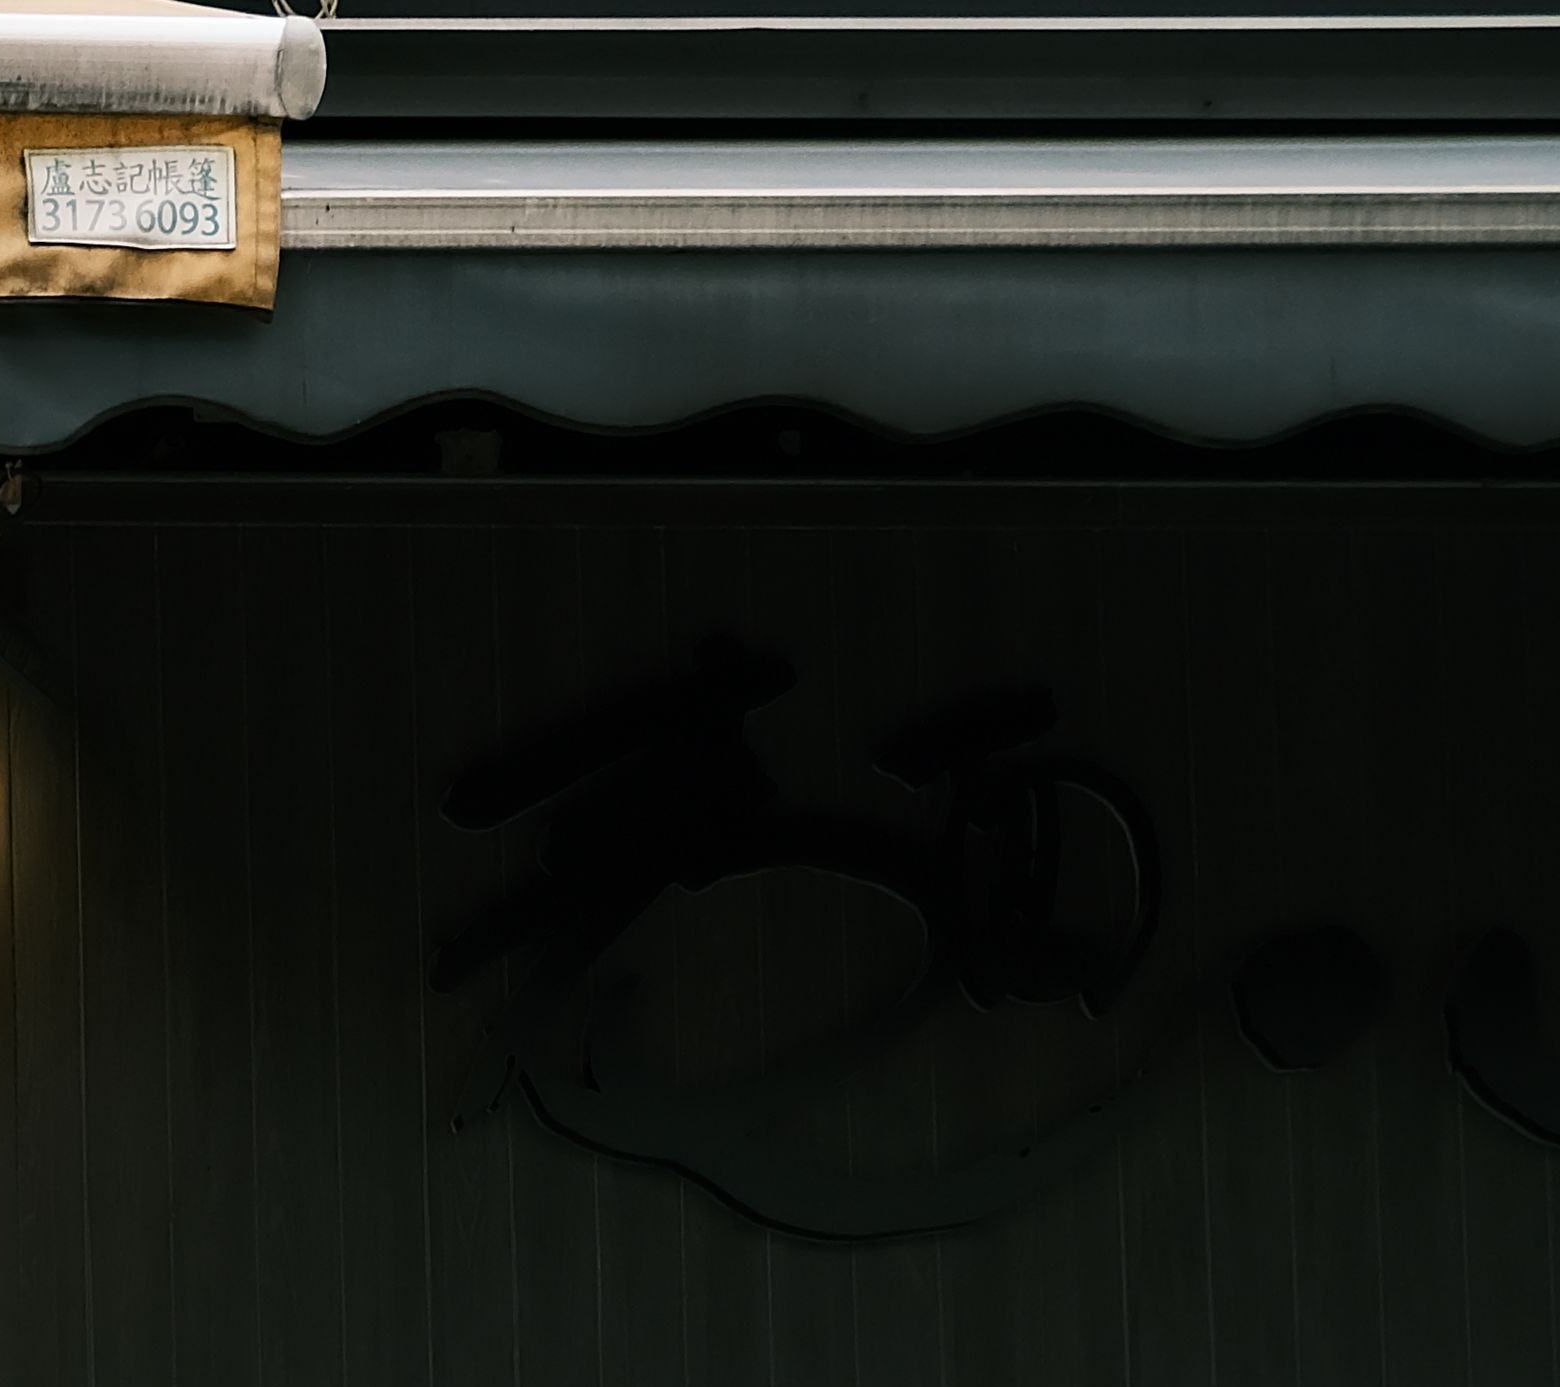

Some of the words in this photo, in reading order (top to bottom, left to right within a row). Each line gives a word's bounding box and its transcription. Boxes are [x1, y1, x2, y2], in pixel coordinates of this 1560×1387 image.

[40, 157, 223, 201] 盧志記帳篷
[41, 198, 128, 232] 3173
[135, 199, 221, 237] 6093
